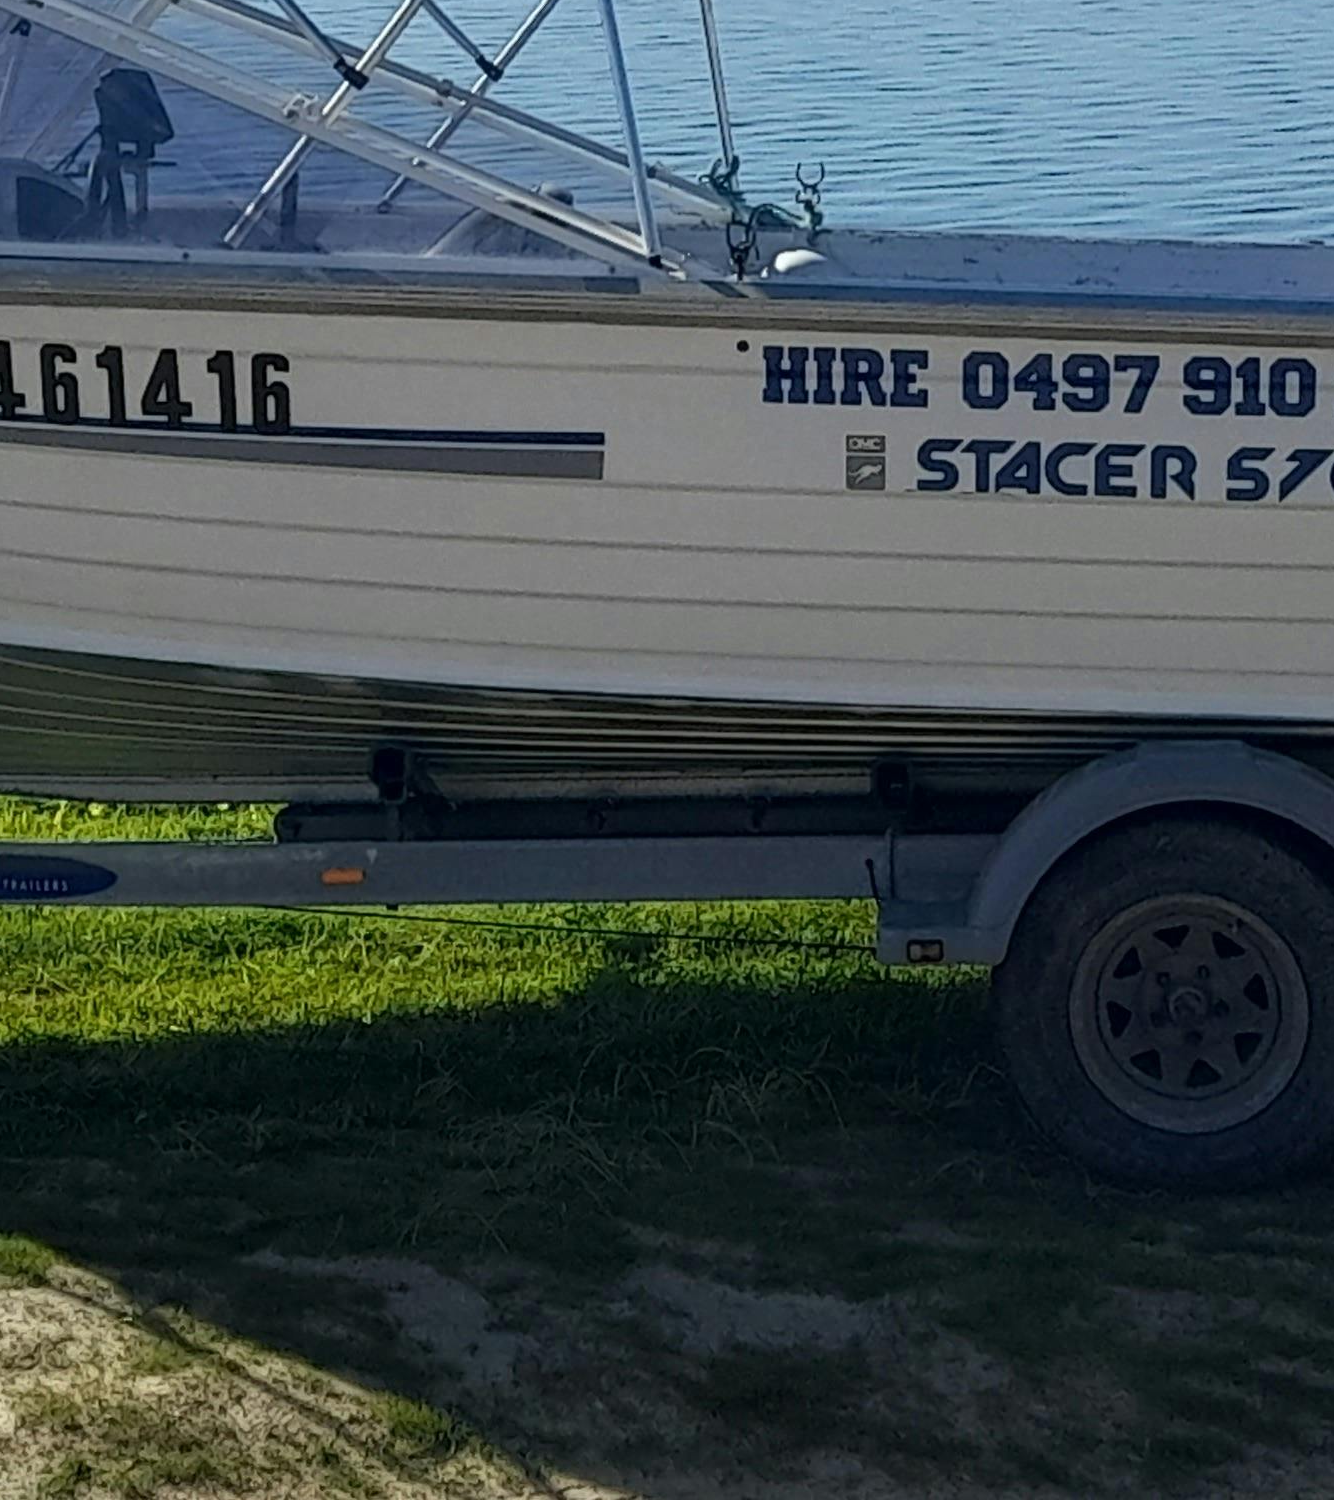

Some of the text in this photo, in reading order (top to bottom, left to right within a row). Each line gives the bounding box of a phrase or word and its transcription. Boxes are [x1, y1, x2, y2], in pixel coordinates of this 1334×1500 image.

[762, 345, 929, 407] HIRE
[962, 351, 1160, 413] 0497
[1183, 356, 1317, 418] 910
[916, 439, 1197, 500] STACER
